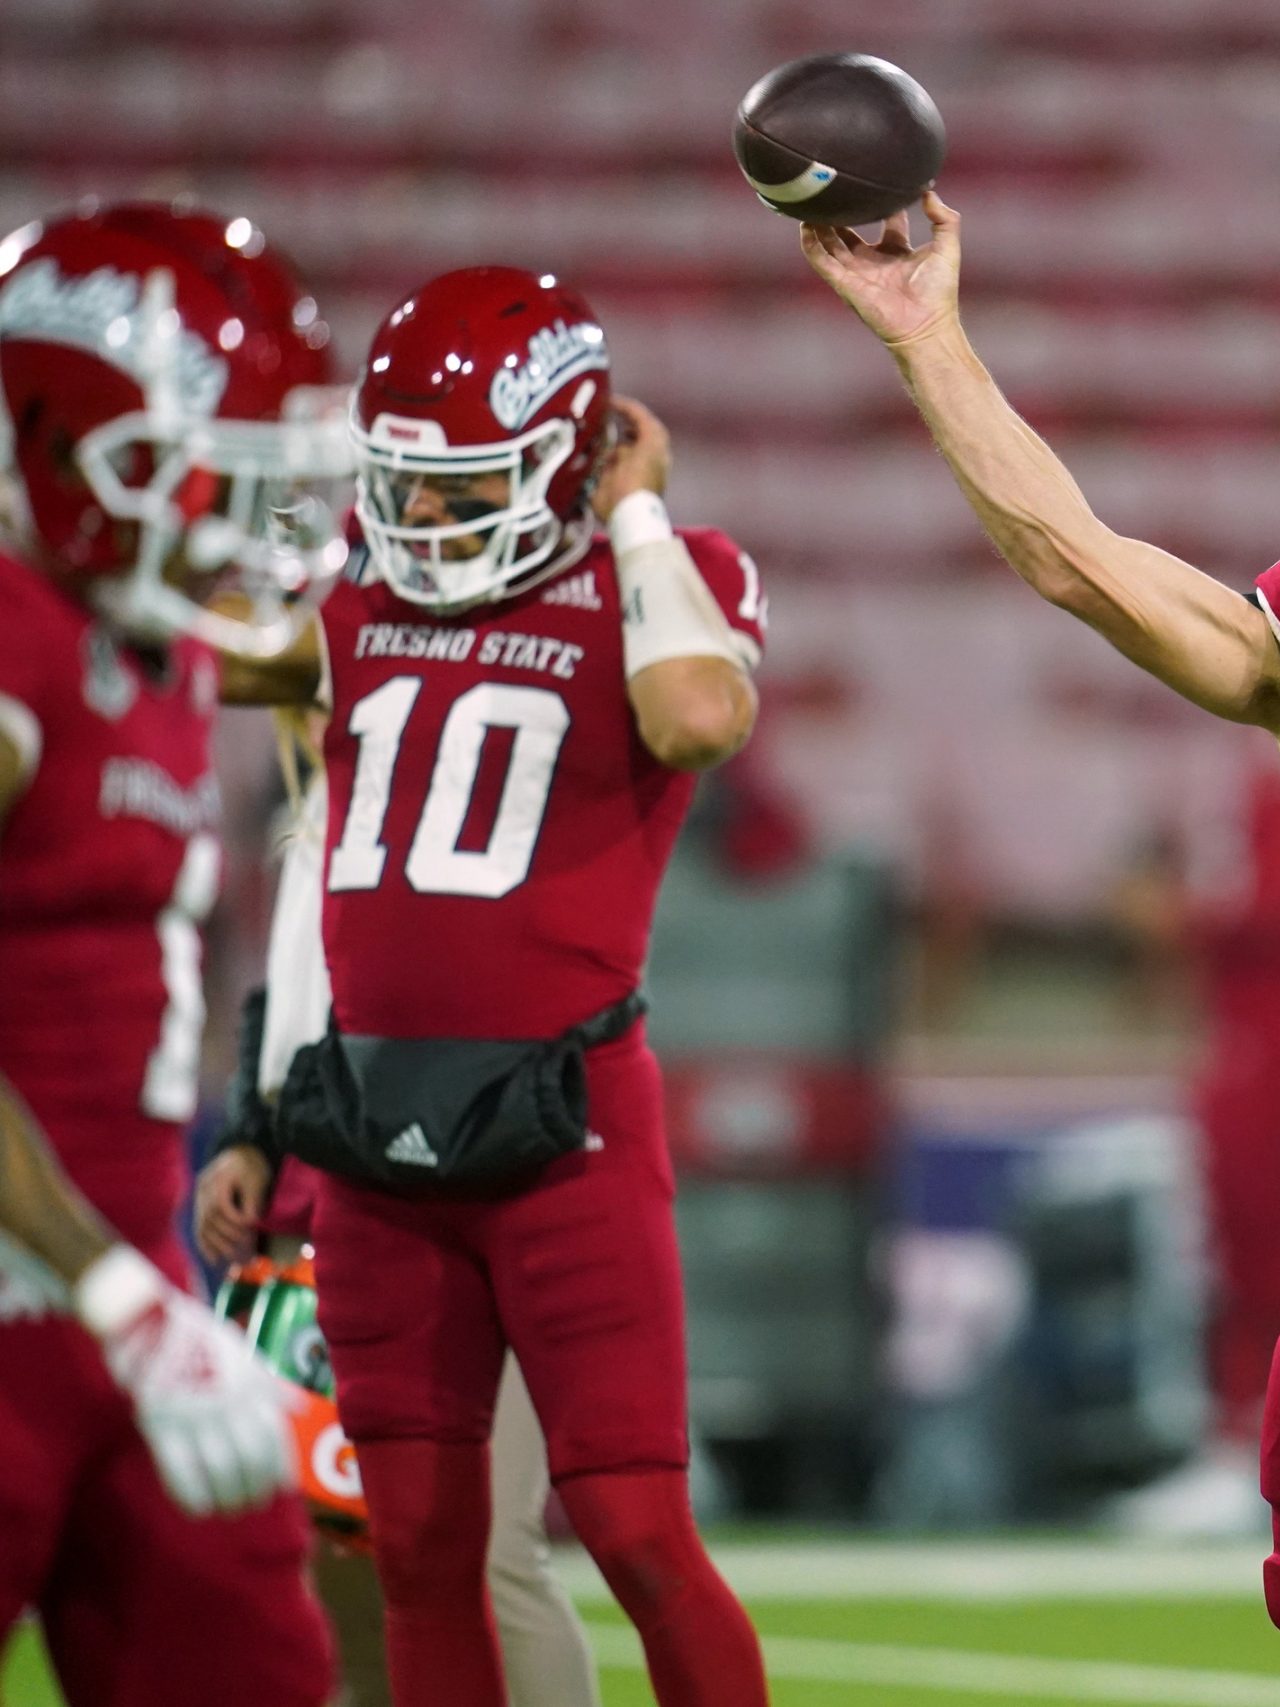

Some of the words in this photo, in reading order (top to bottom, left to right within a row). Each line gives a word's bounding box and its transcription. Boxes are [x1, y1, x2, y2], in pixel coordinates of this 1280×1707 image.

[354, 622, 476, 662] FRESNO
[477, 631, 584, 679] STATE
[328, 674, 572, 900] 10
